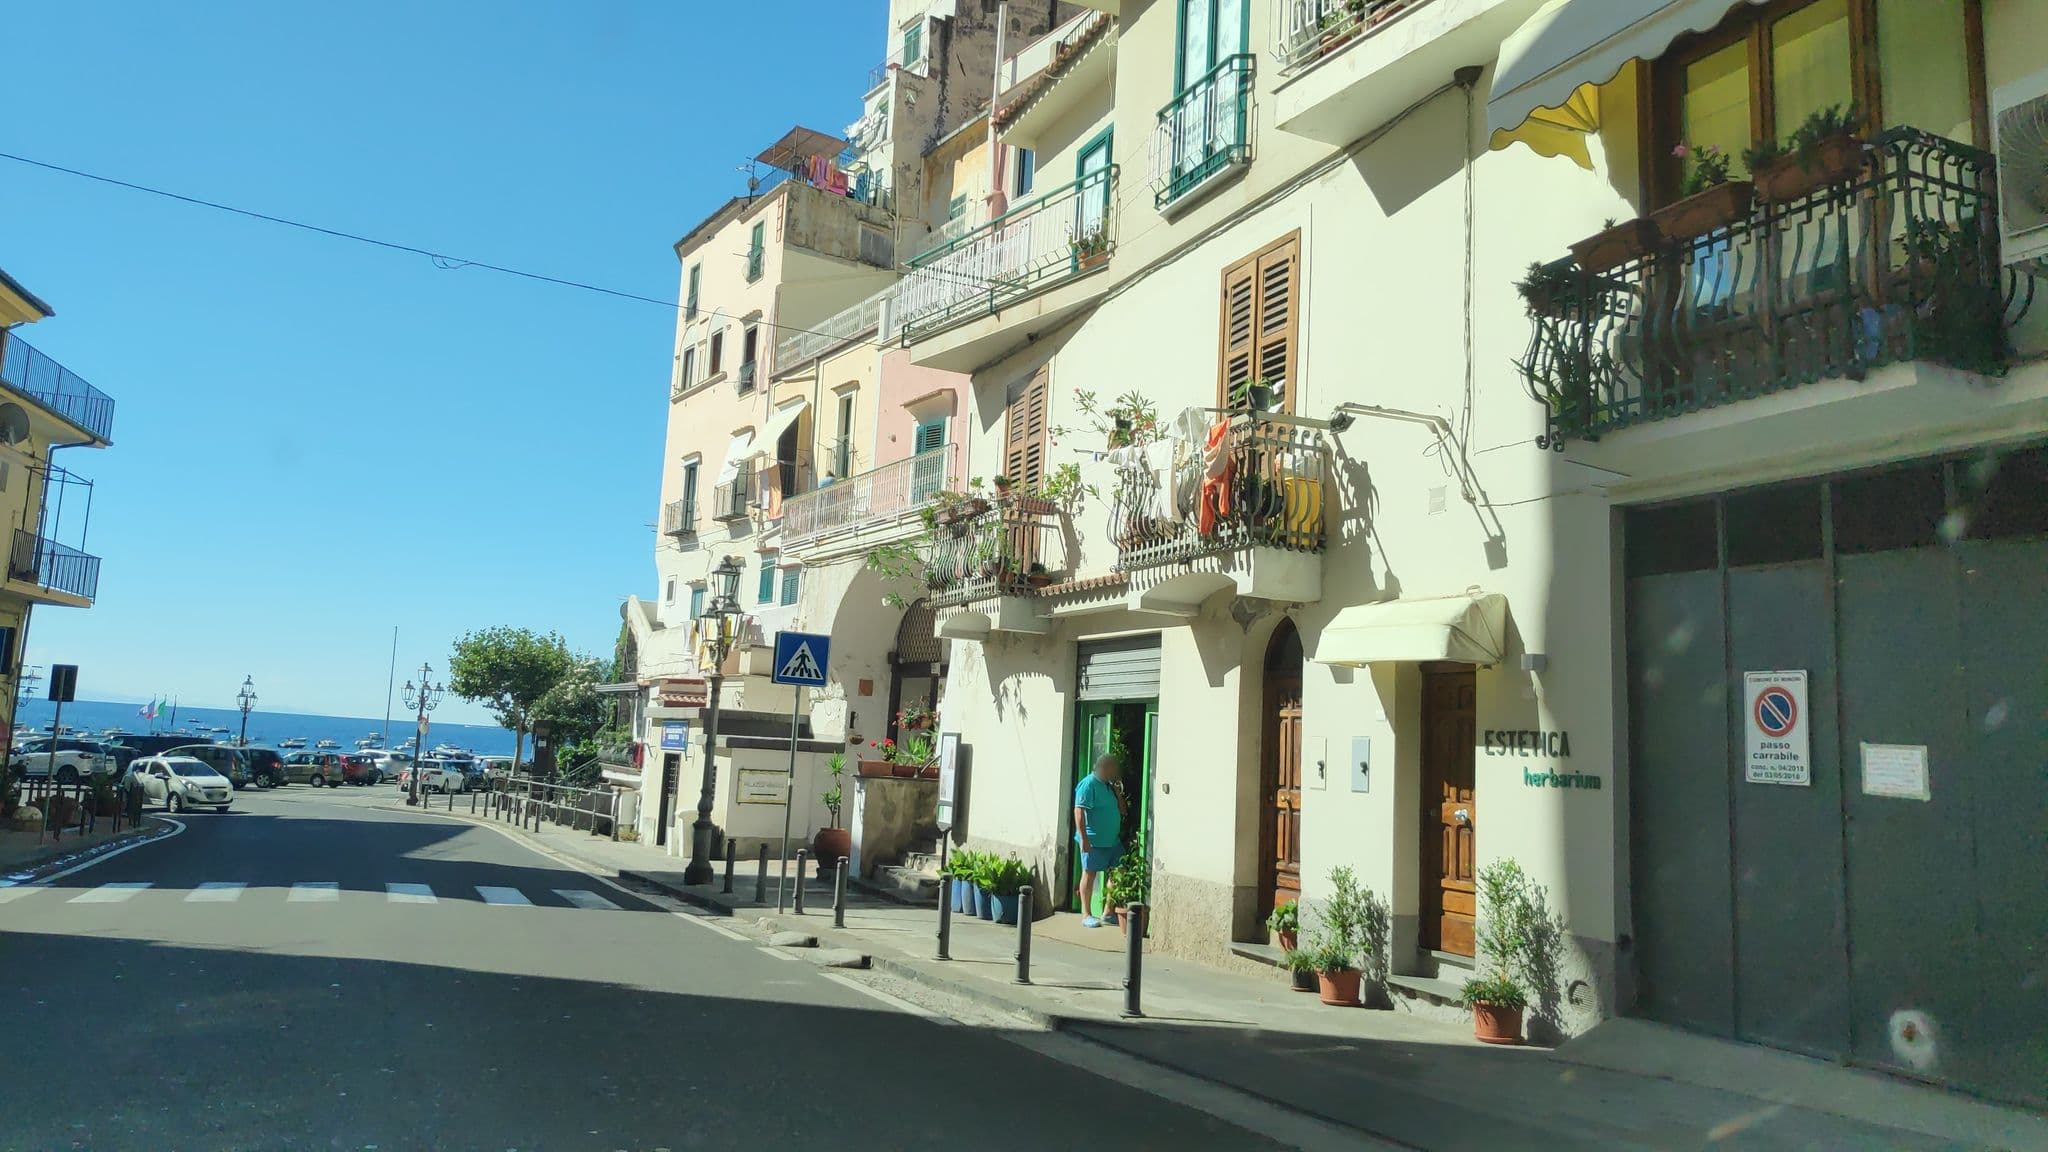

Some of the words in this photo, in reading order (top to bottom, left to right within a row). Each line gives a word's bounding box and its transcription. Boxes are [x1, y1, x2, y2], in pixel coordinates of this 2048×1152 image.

[1484, 730, 1570, 757] ESTETICA
[1760, 742, 1791, 750] passo
[1752, 752, 1799, 761] carrabile
[1523, 766, 1601, 790] herbarium
